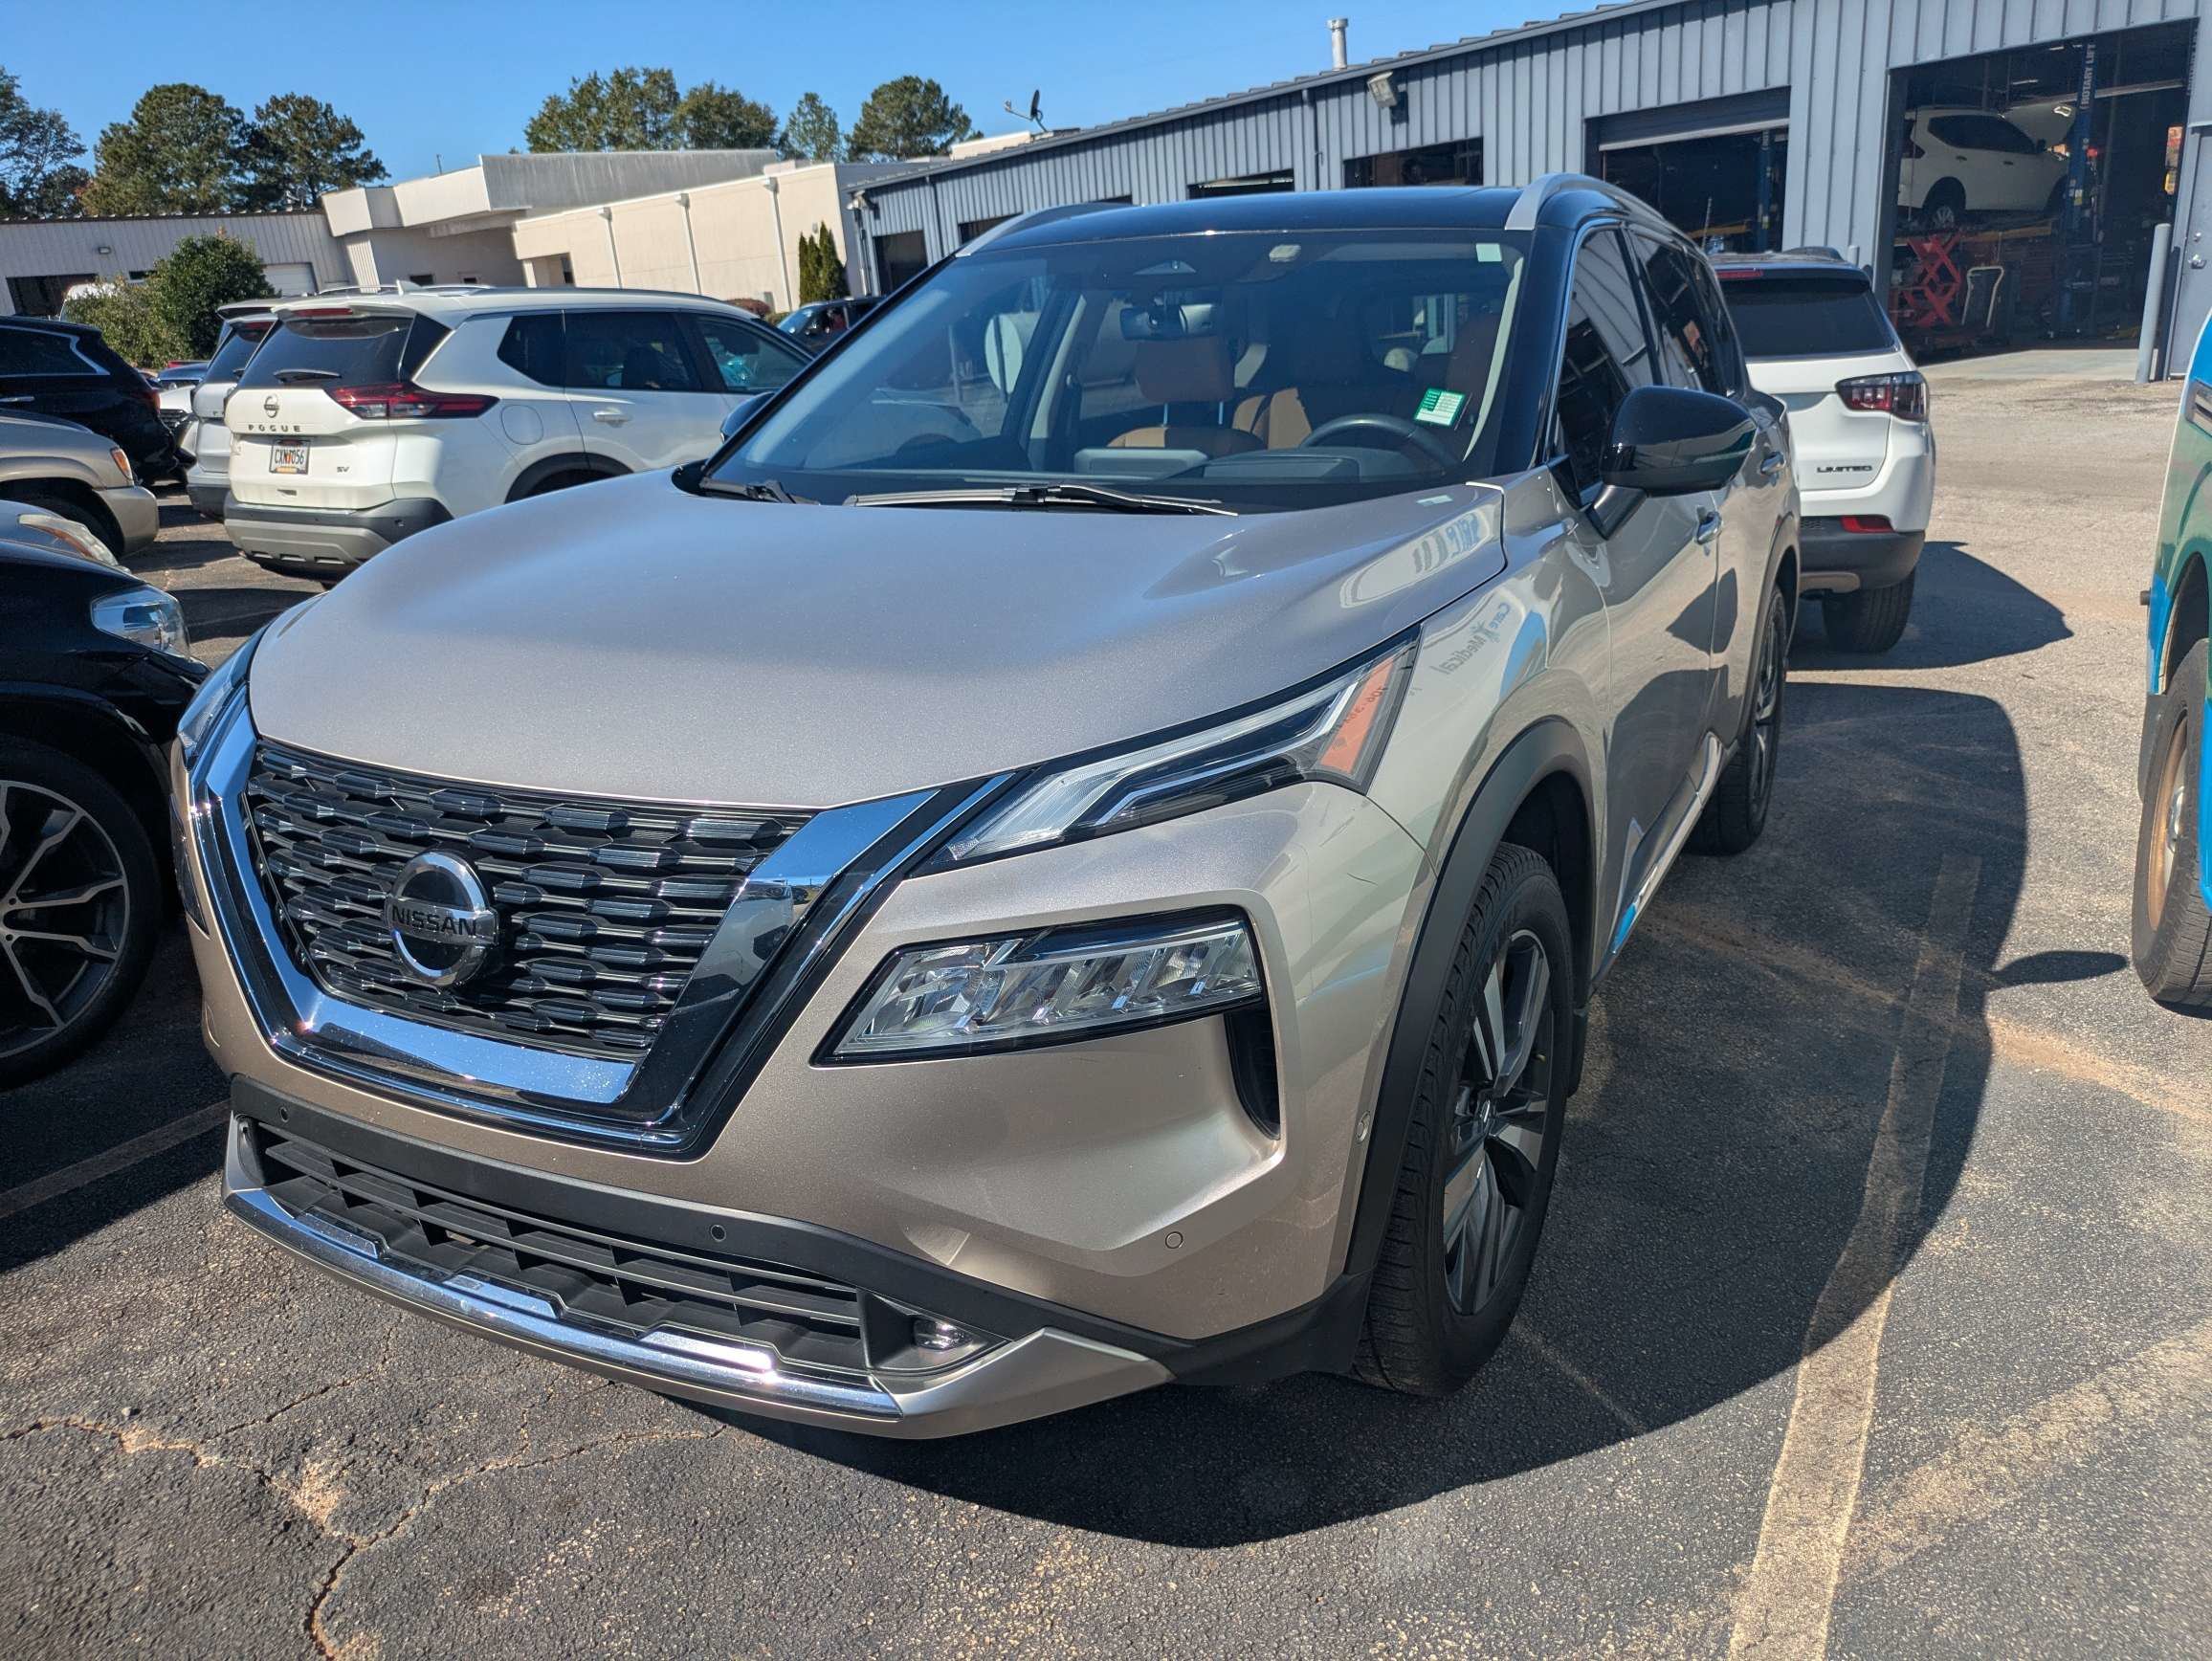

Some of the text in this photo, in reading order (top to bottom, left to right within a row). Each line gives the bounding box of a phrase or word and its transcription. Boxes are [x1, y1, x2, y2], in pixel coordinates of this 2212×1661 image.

[2080, 44, 2095, 105] ROTARY LIFT
[1816, 465, 1873, 474] LIMITED
[391, 904, 477, 937] NISSAN
